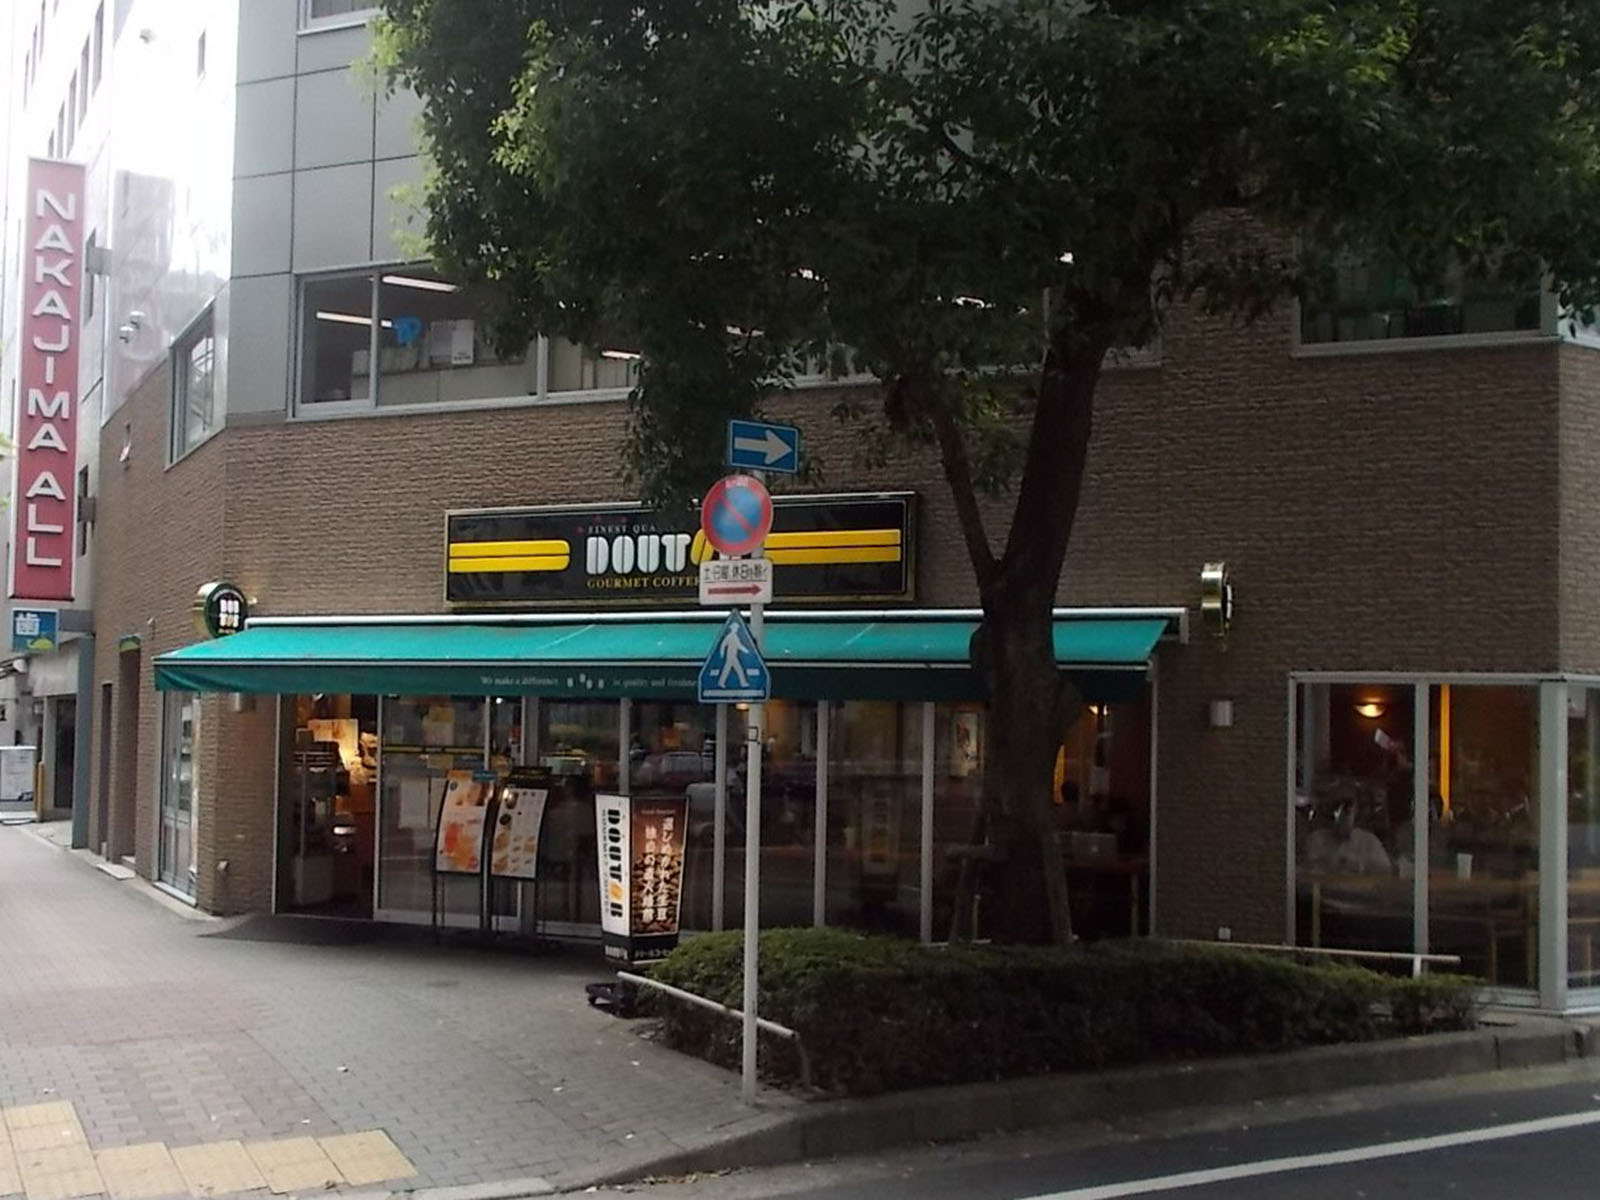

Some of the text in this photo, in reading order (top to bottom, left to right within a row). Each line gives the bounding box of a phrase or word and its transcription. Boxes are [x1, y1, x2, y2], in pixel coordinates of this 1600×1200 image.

[25, 189, 75, 567] NAKAJIMA ALL
[586, 577, 648, 589] GOURMET
[15, 612, 40, 635] 歯
